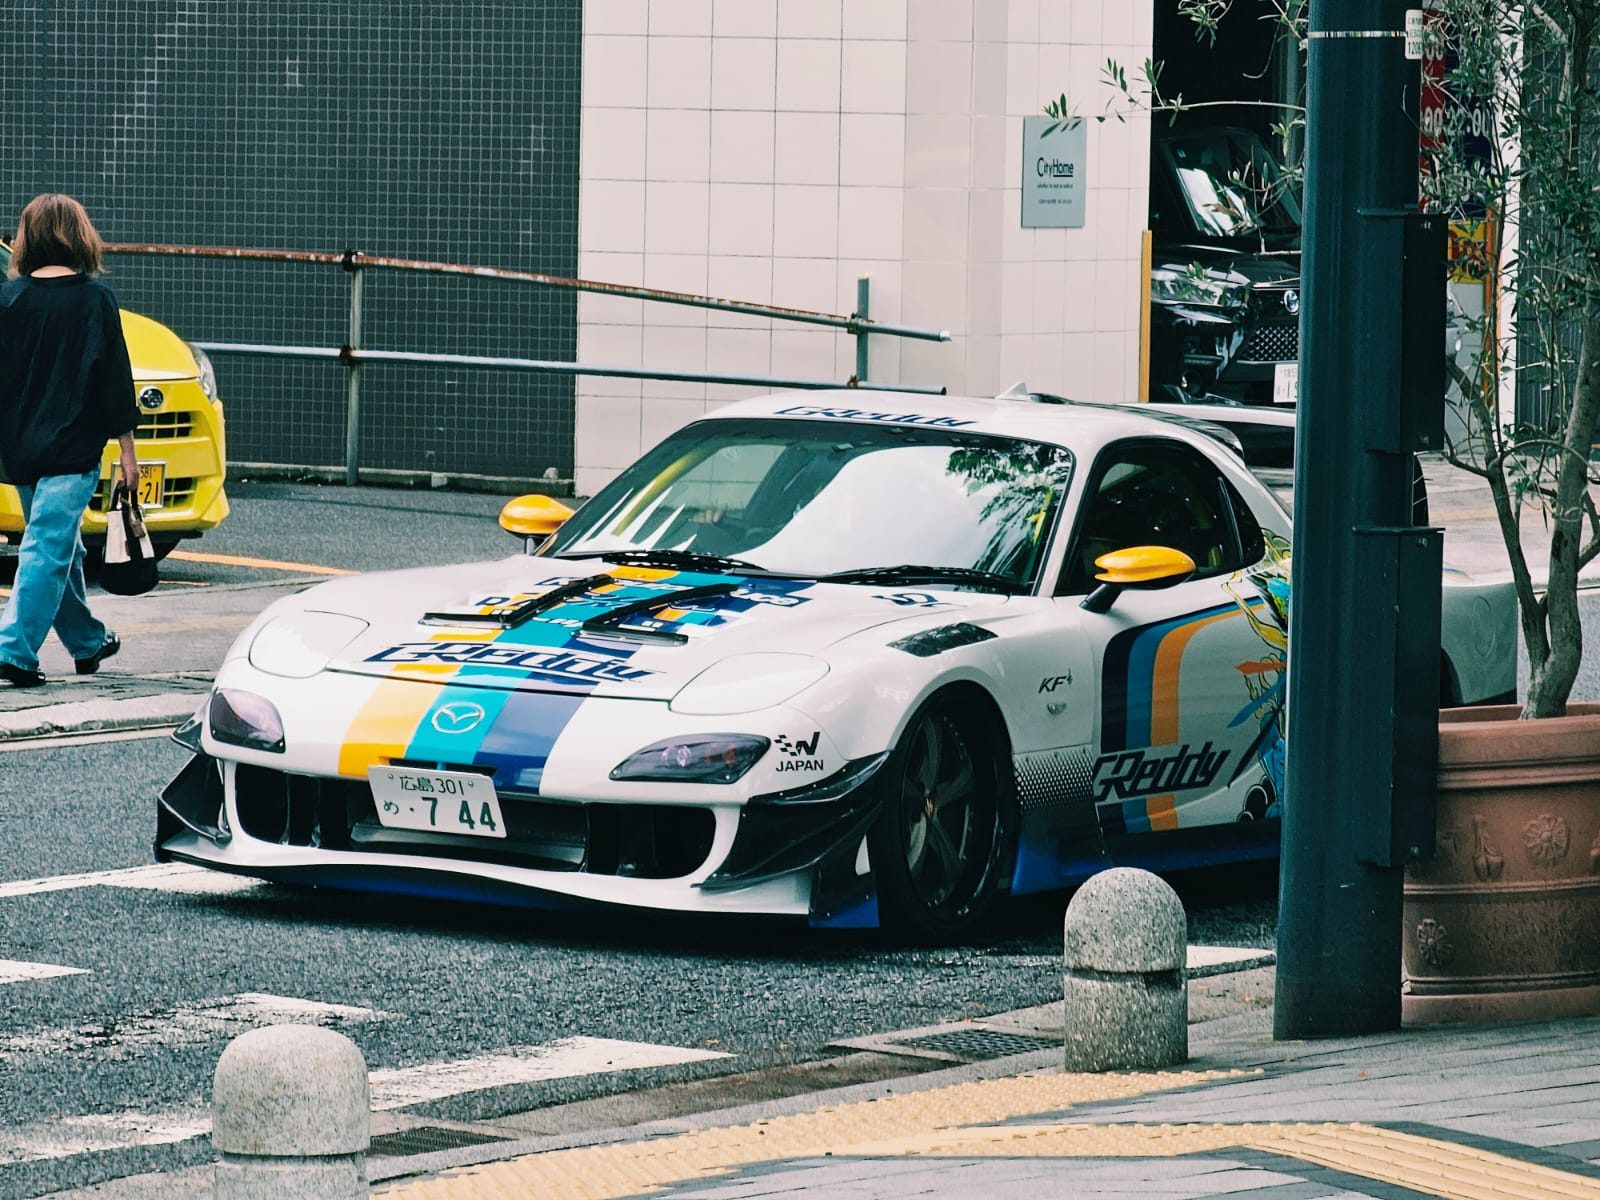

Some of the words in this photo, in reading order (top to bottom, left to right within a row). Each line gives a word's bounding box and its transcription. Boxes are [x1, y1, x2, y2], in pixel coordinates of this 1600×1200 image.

[773, 405, 978, 427] GReddy
[362, 642, 655, 682] GReddy
[776, 760, 824, 772] JAPAN
[1093, 741, 1231, 801] GReddy
